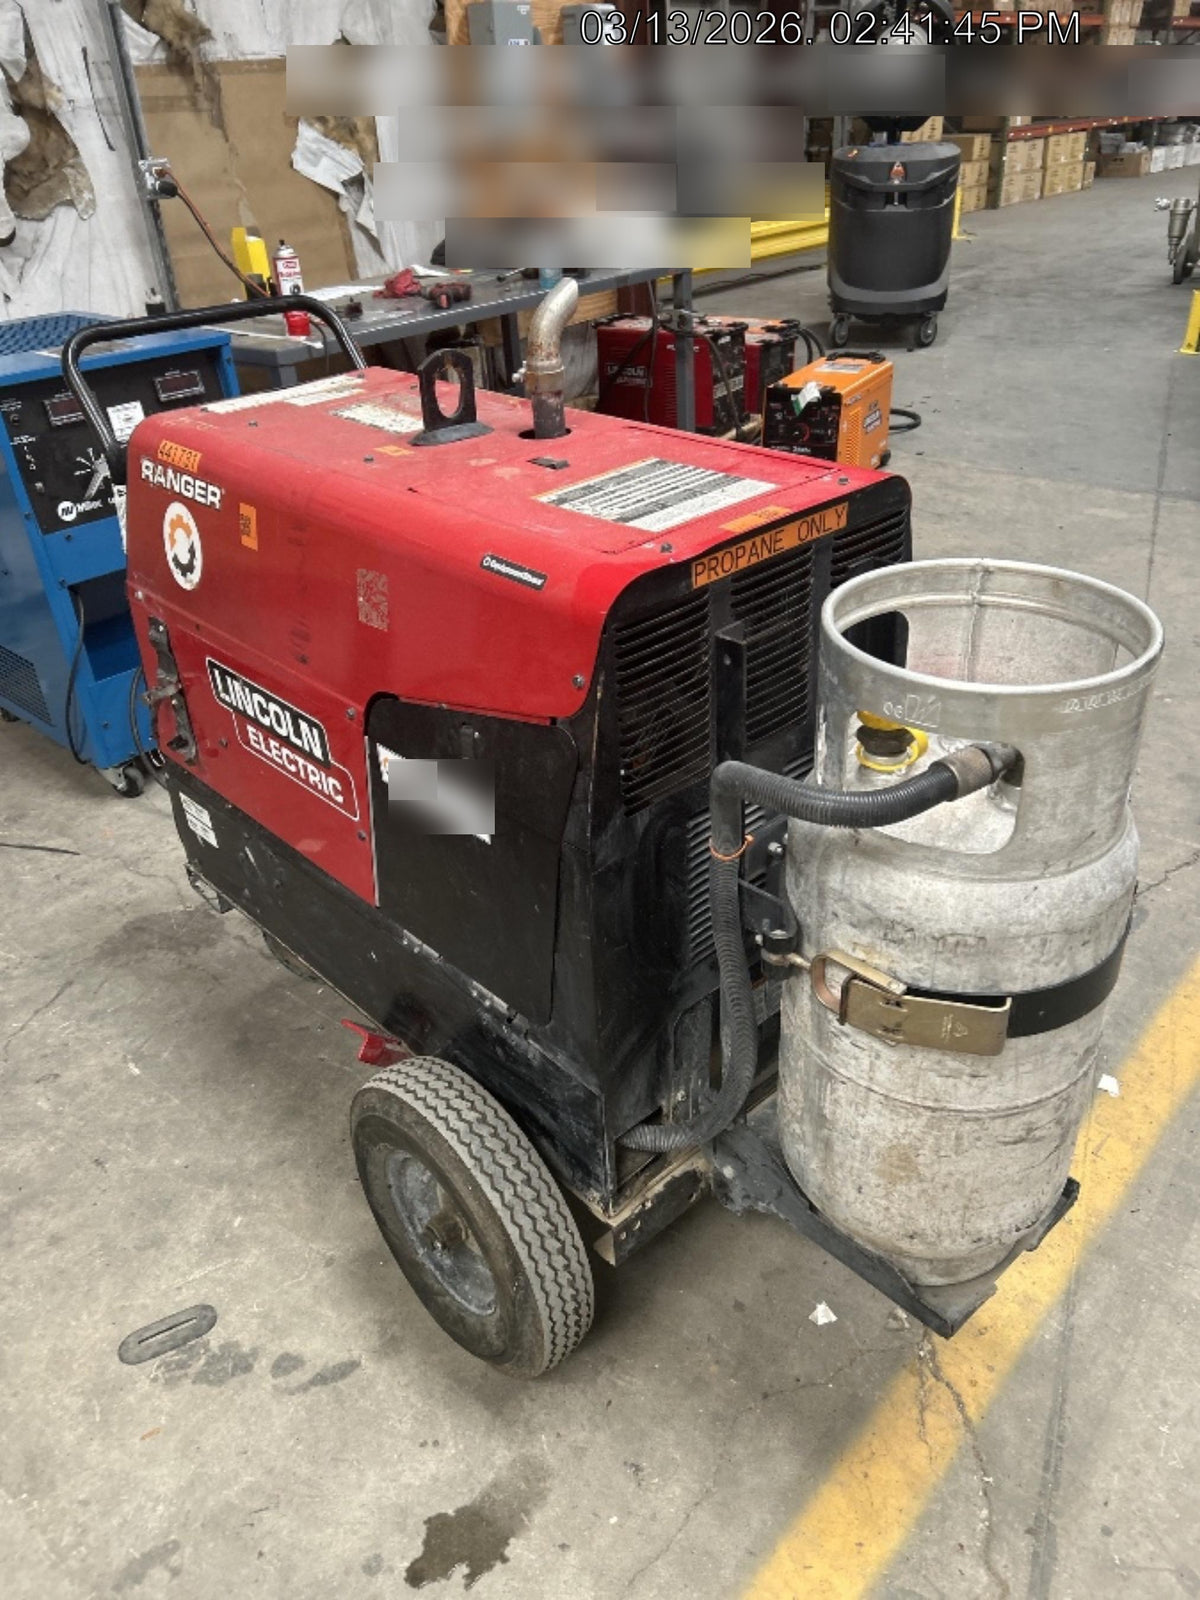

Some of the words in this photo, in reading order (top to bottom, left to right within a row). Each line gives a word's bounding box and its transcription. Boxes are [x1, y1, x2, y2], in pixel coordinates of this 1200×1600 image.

[141, 459, 221, 509] RANGER
[694, 529, 785, 586] PROPANE
[798, 506, 846, 541] ONLY
[213, 668, 324, 761] LINCOLN
[246, 724, 344, 804] ELECTRIC
